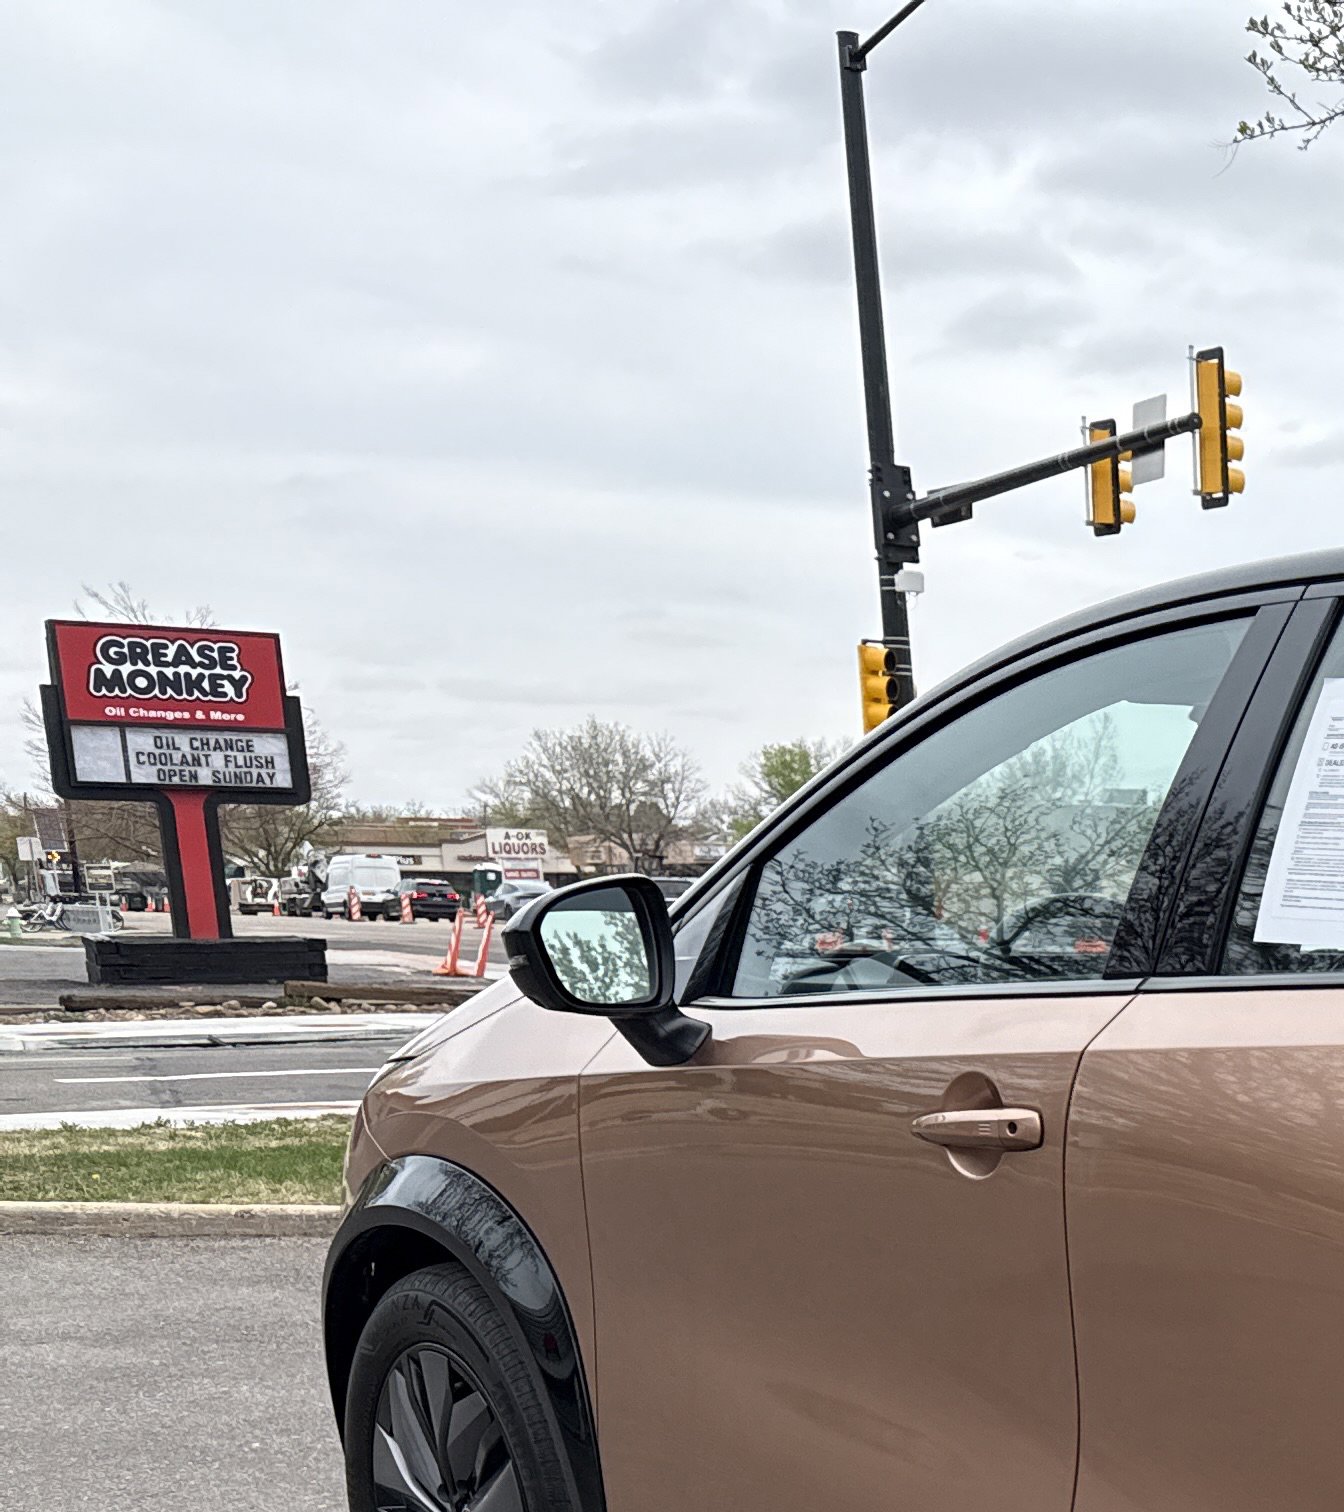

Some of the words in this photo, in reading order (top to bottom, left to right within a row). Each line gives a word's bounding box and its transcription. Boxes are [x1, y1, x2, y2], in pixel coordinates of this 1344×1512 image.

[98, 637, 240, 672] GREASE
[91, 667, 250, 700] MONKEY
[104, 706, 125, 717] Oil
[128, 707, 191, 720] Changes
[195, 709, 205, 720] &
[210, 710, 245, 722] More
[153, 735, 181, 750] OIL
[189, 736, 255, 753] CHANGE
[135, 751, 212, 767] COOLANT
[224, 753, 276, 770] FLUSH
[157, 768, 199, 784] OPEN
[211, 769, 277, 786] SUNDAY
[504, 831, 532, 841] A-OK
[491, 842, 547, 855] LIQUORS
